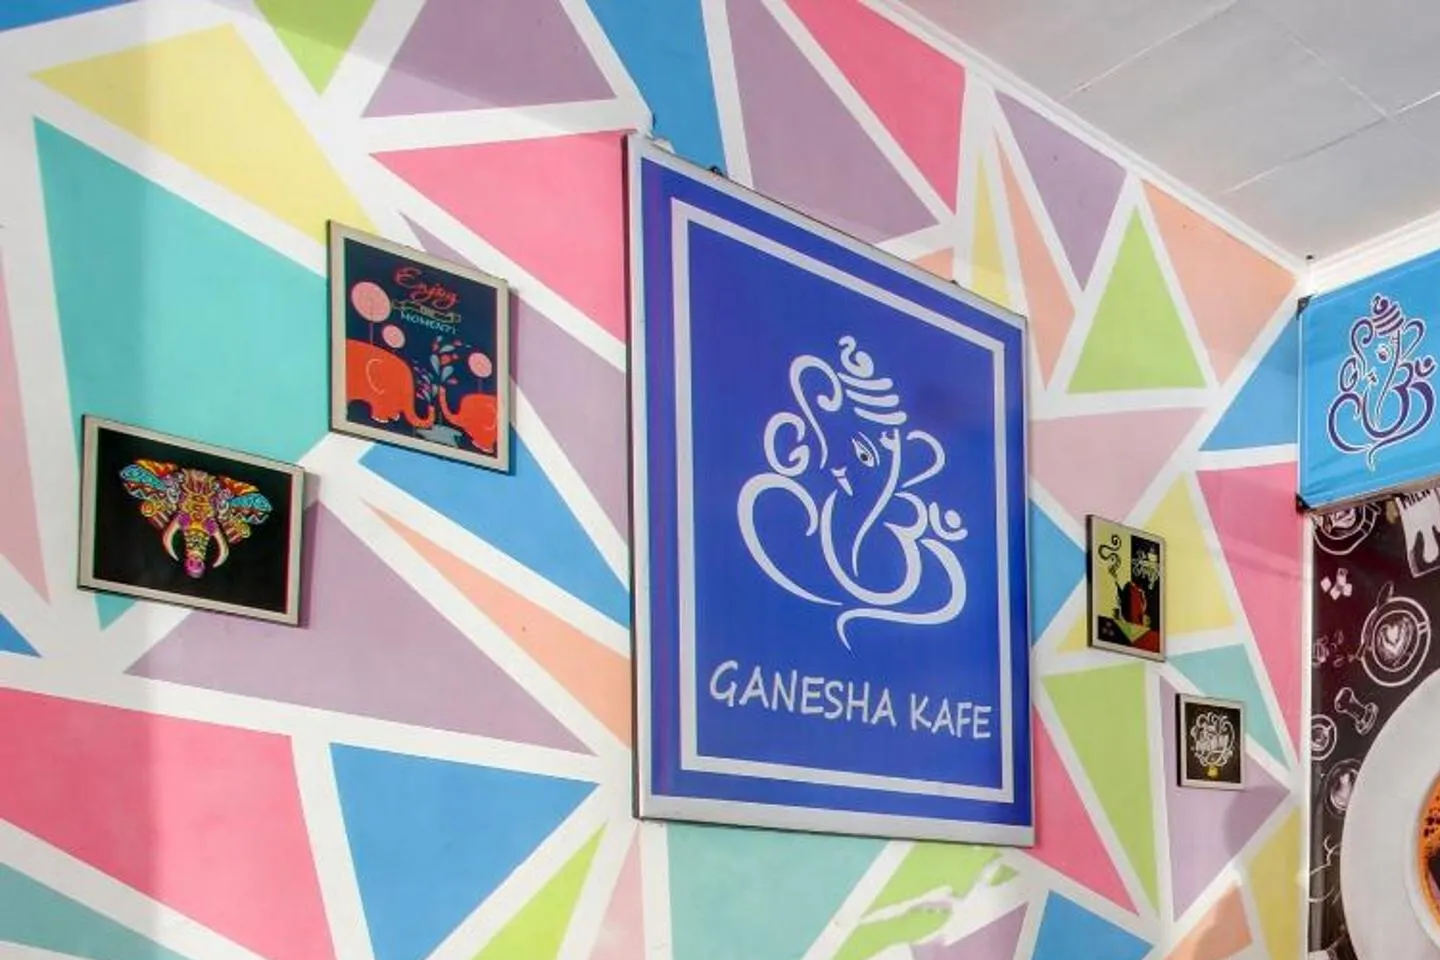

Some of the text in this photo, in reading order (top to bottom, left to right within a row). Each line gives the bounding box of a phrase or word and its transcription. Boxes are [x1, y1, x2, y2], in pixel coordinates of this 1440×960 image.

[393, 266, 459, 311] Enjoy
[708, 659, 992, 740] GANESHA KAFE
